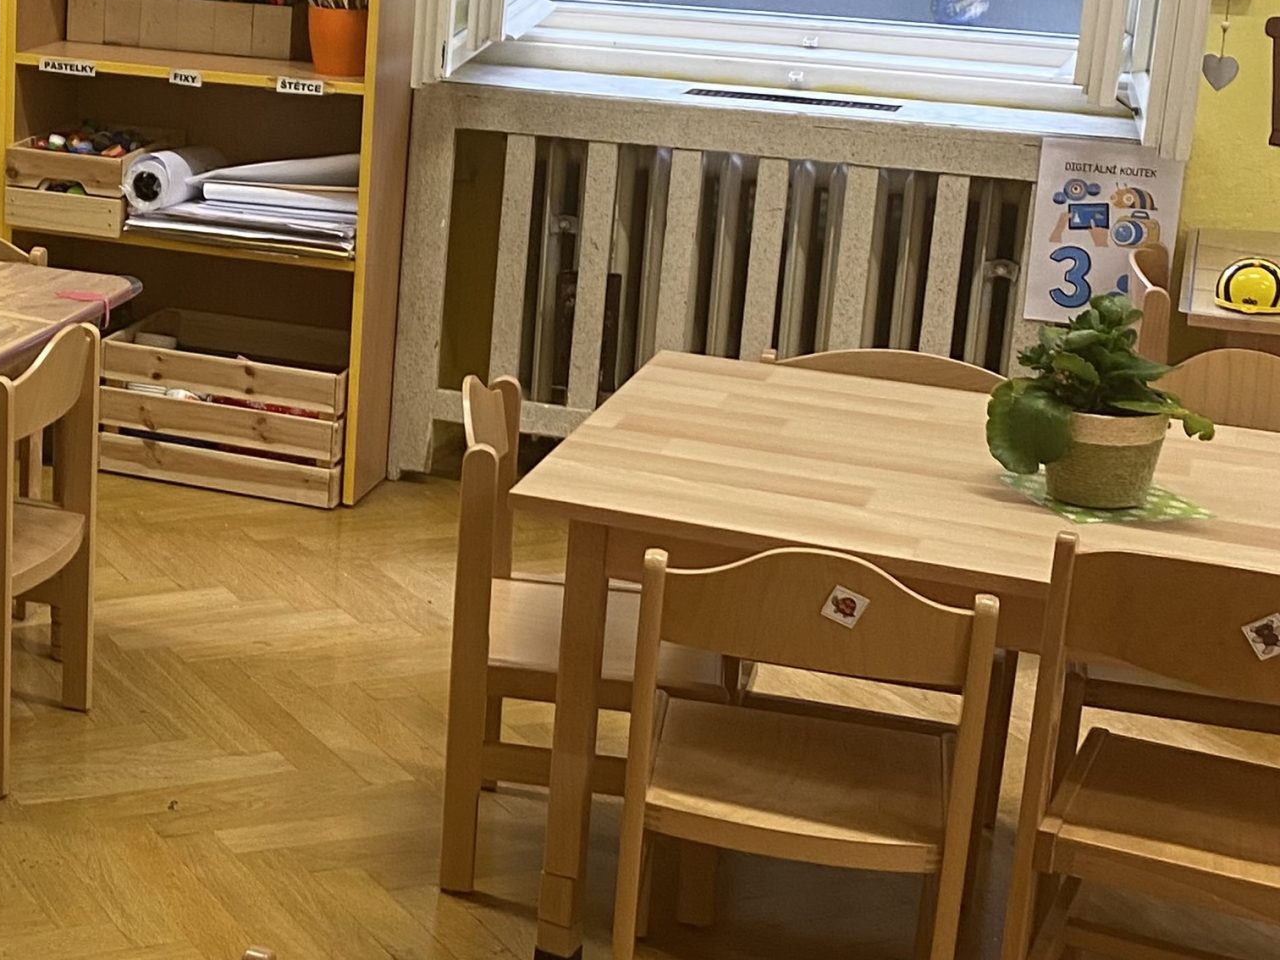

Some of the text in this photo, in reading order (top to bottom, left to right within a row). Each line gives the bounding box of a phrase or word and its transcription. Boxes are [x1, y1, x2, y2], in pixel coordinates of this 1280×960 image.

[44, 61, 95, 74] PASTELKY
[173, 72, 197, 84] FIXY
[1064, 162, 1157, 178] DIGITÁLNÍ KOUTEK
[1049, 245, 1092, 309] 3
